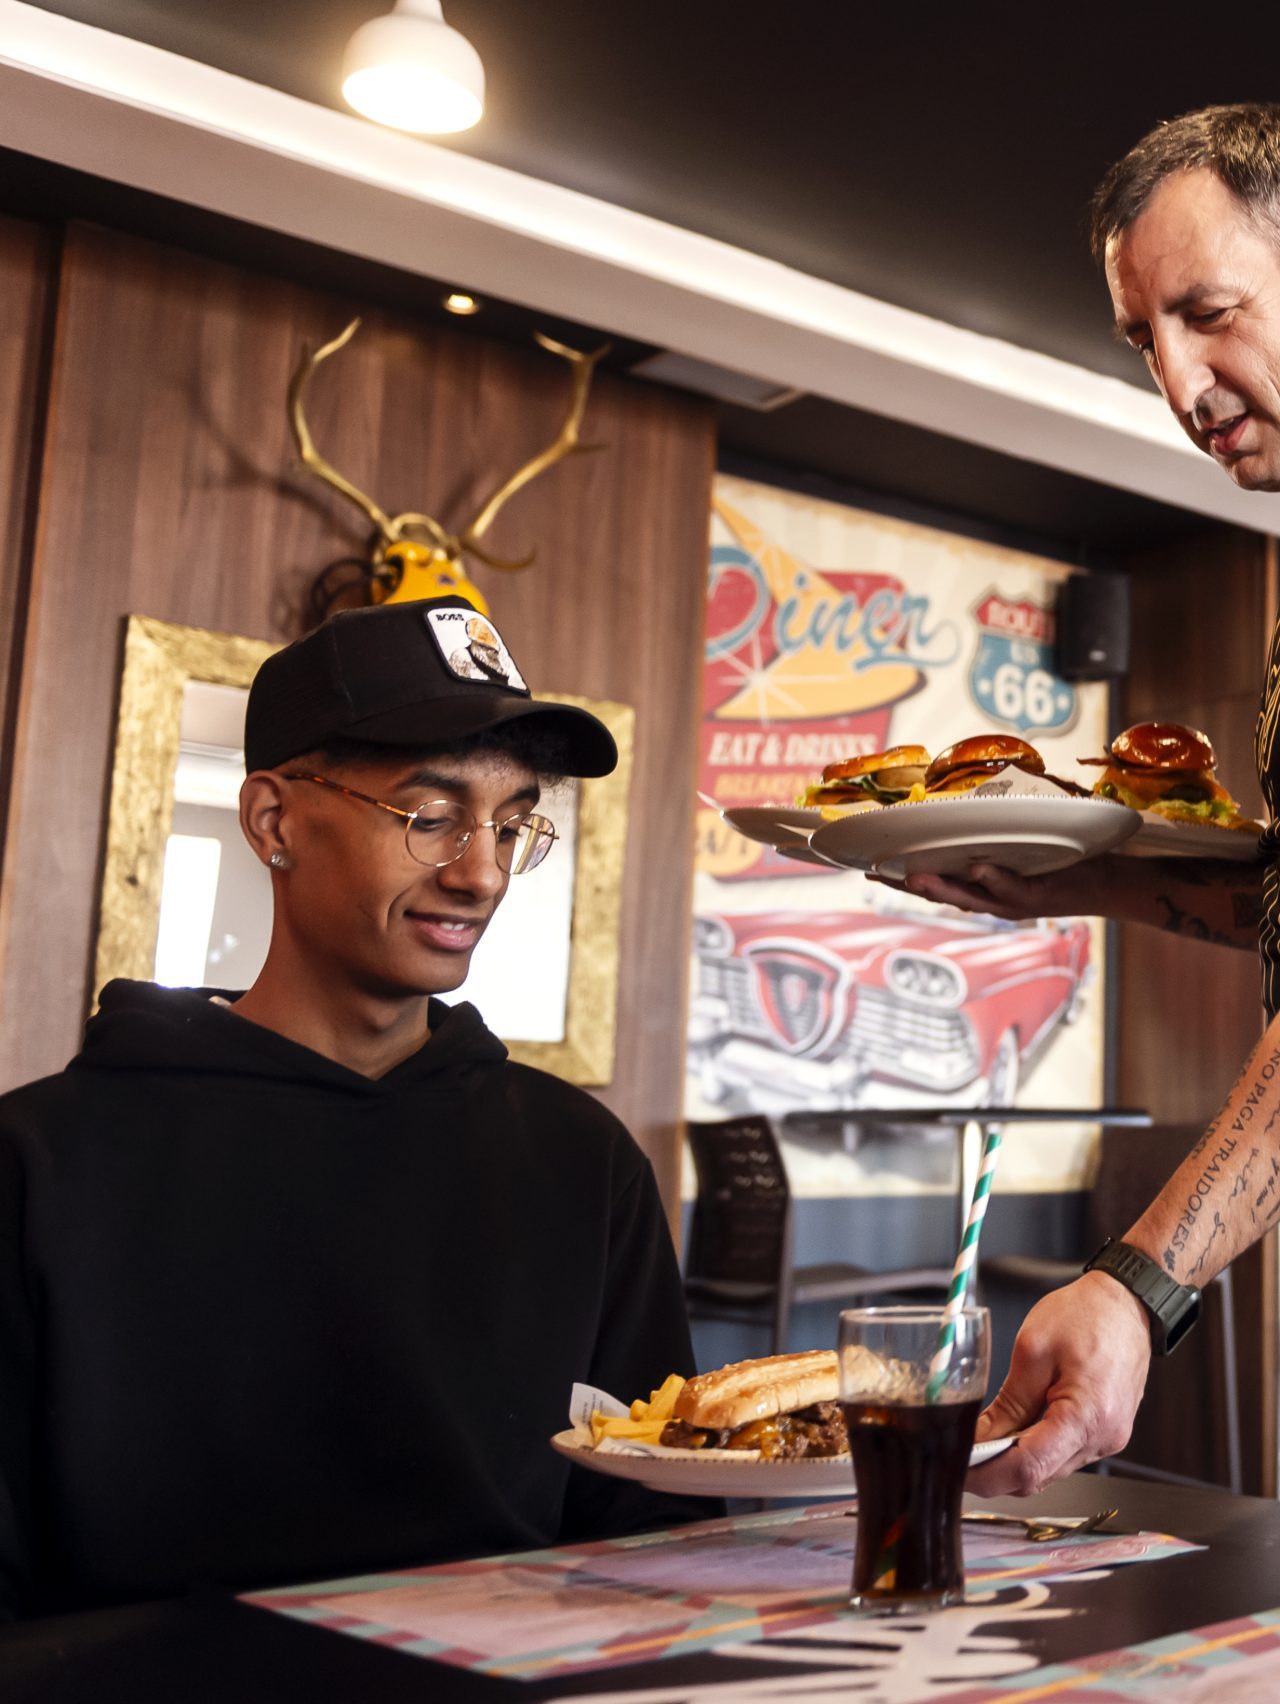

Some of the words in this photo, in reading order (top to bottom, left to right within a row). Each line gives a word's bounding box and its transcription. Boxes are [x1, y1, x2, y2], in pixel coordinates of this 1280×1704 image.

[987, 600, 1056, 642] ROU
[993, 662, 1055, 725] 66
[708, 733, 763, 765] EAT
[1230, 1081, 1267, 1132] PAGA
[1170, 1136, 1238, 1252] TRAIDORES
